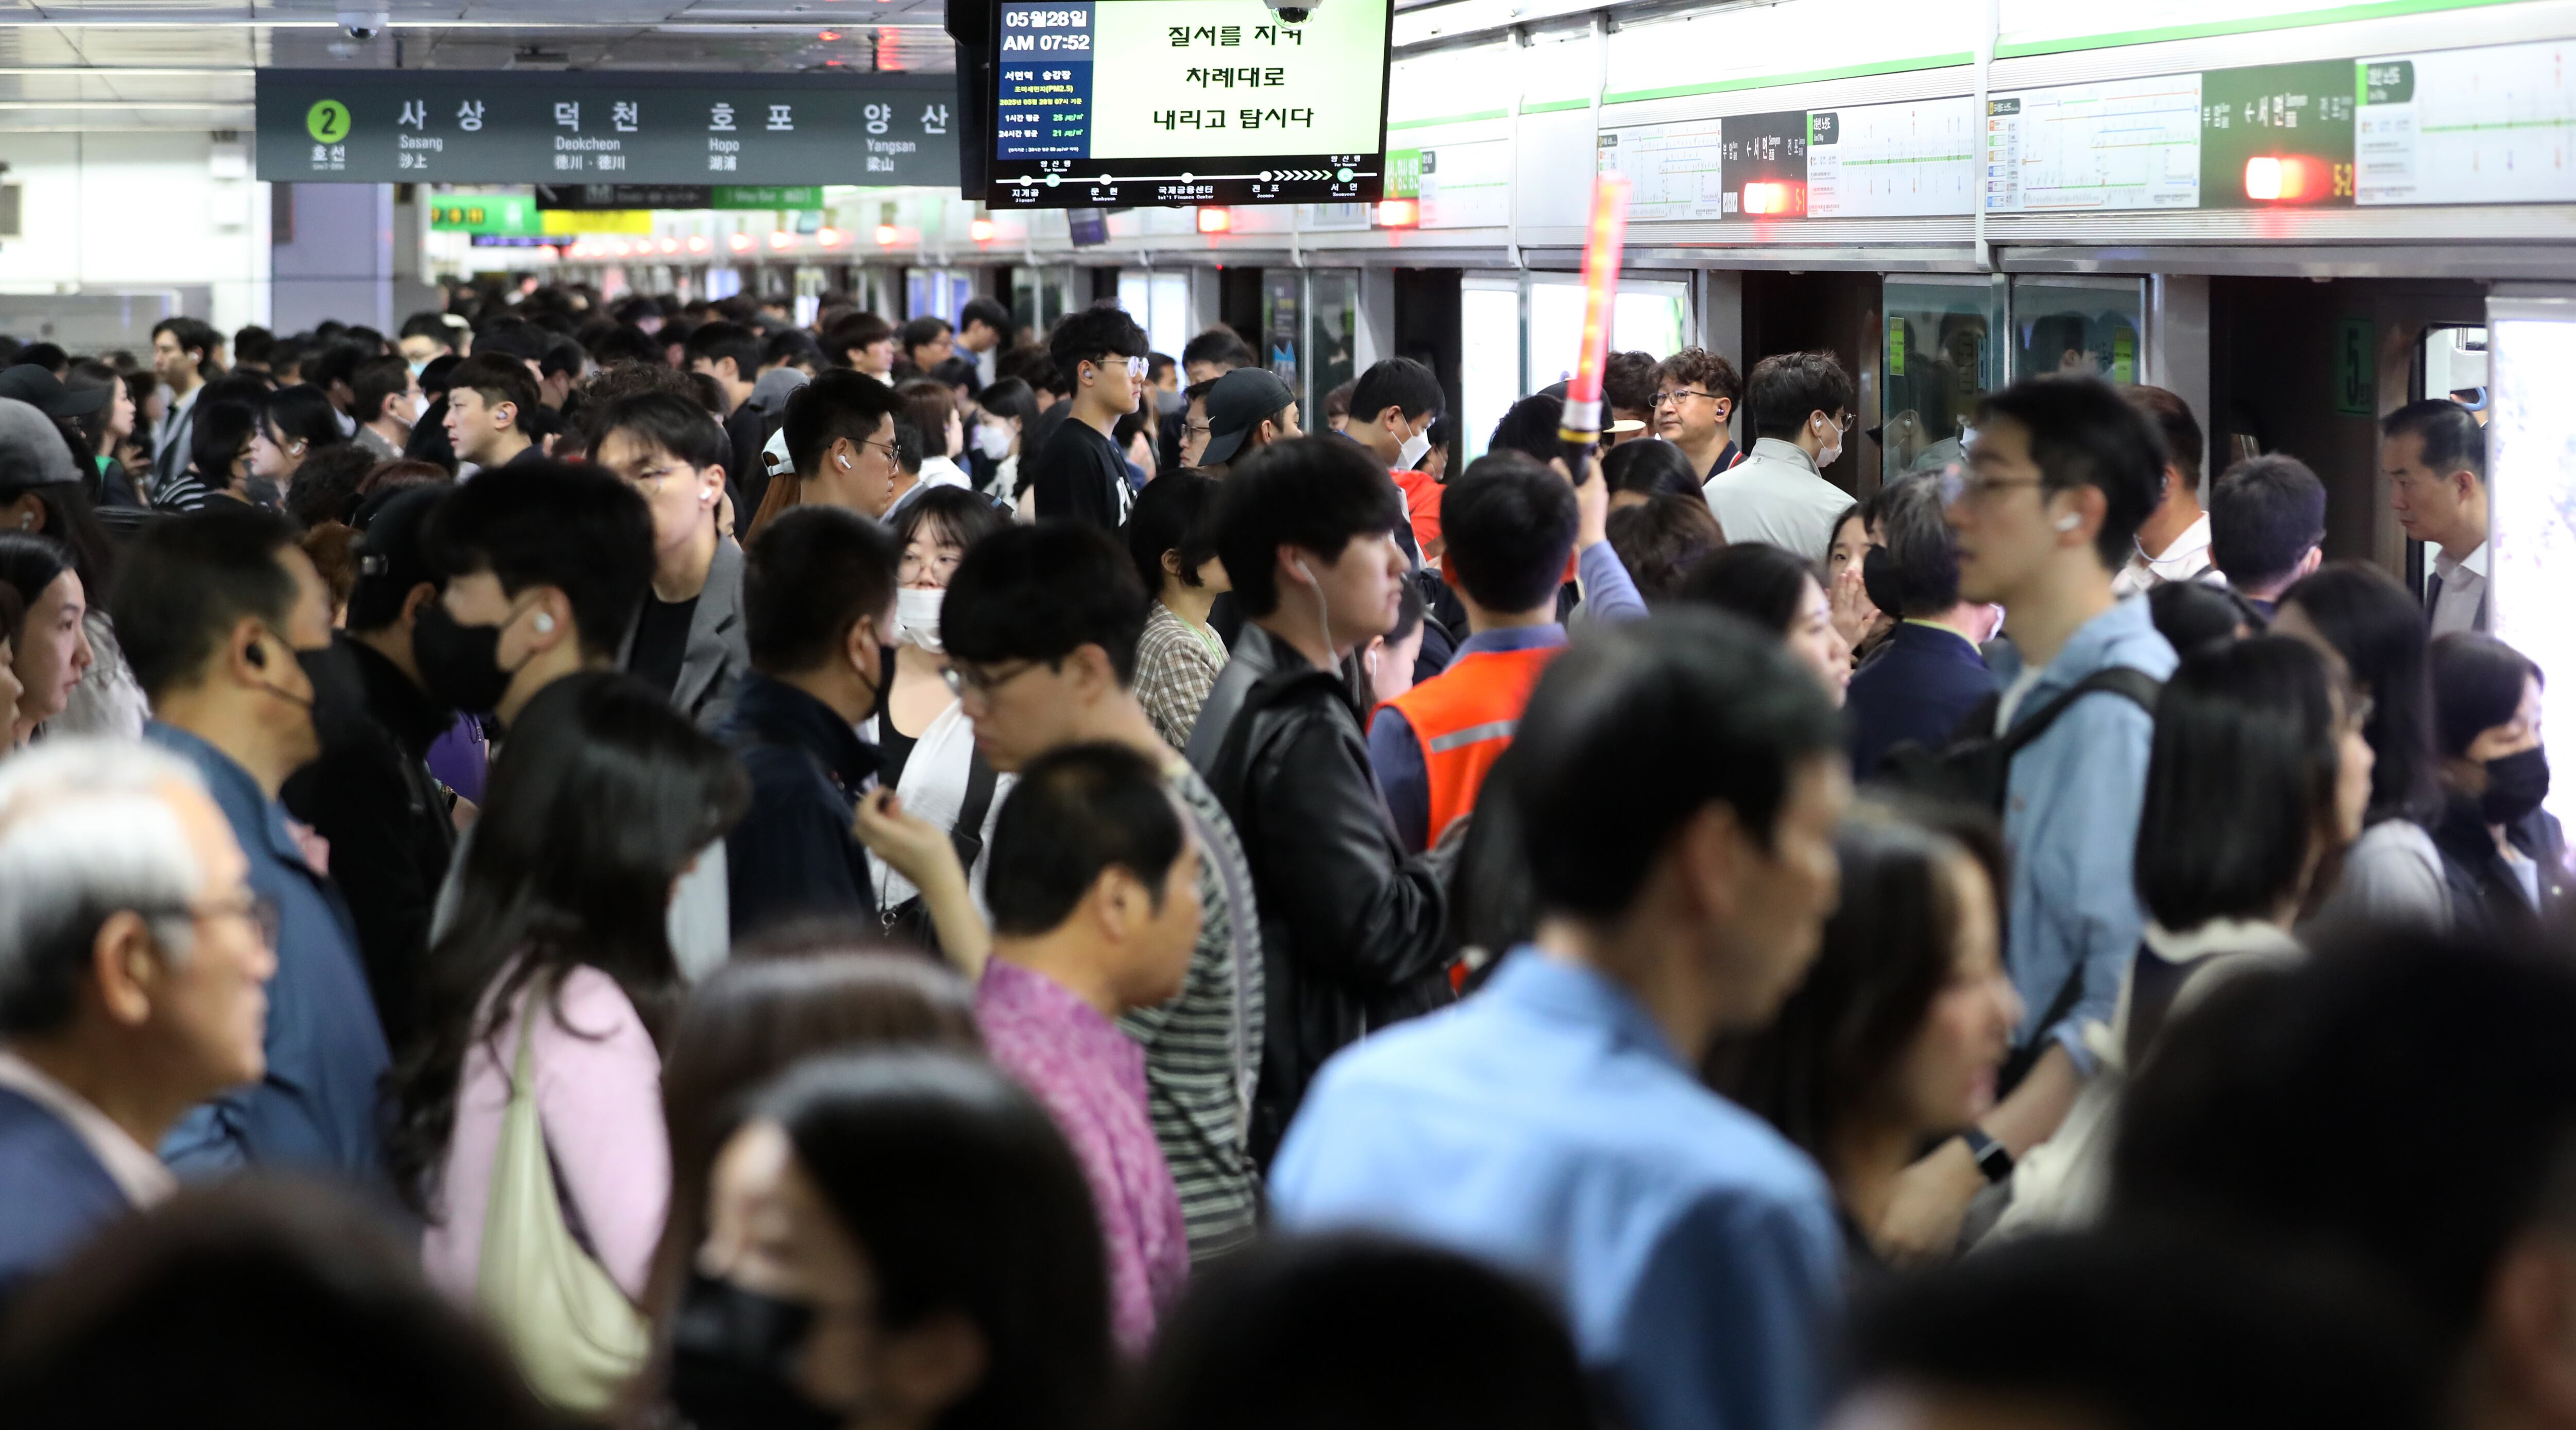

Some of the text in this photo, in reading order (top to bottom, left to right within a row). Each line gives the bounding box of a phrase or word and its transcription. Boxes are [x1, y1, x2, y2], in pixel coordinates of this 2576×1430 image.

[1006, 10, 1087, 27] 05월28일
[1003, 35, 1090, 50] AM 07:52
[1168, 26, 1241, 47] 질서를
[1005, 70, 1072, 81] 서면역 승강장
[1186, 67, 1284, 88] 차례대로
[322, 107, 337, 134] 2
[1005, 114, 1024, 122] 1시간
[1154, 108, 1314, 130] 내리고 탑시다
[998, 130, 1023, 138] 24시간
[400, 135, 443, 151] Sasang
[554, 135, 621, 151] Deokcheon
[708, 138, 740, 153] Hopo
[866, 139, 916, 154] Yangsan
[2333, 163, 2353, 197] 5-2
[1011, 189, 1040, 197] 지게골
[1158, 185, 1213, 194] 국제금융센터
[1795, 188, 1805, 212] 5-1
